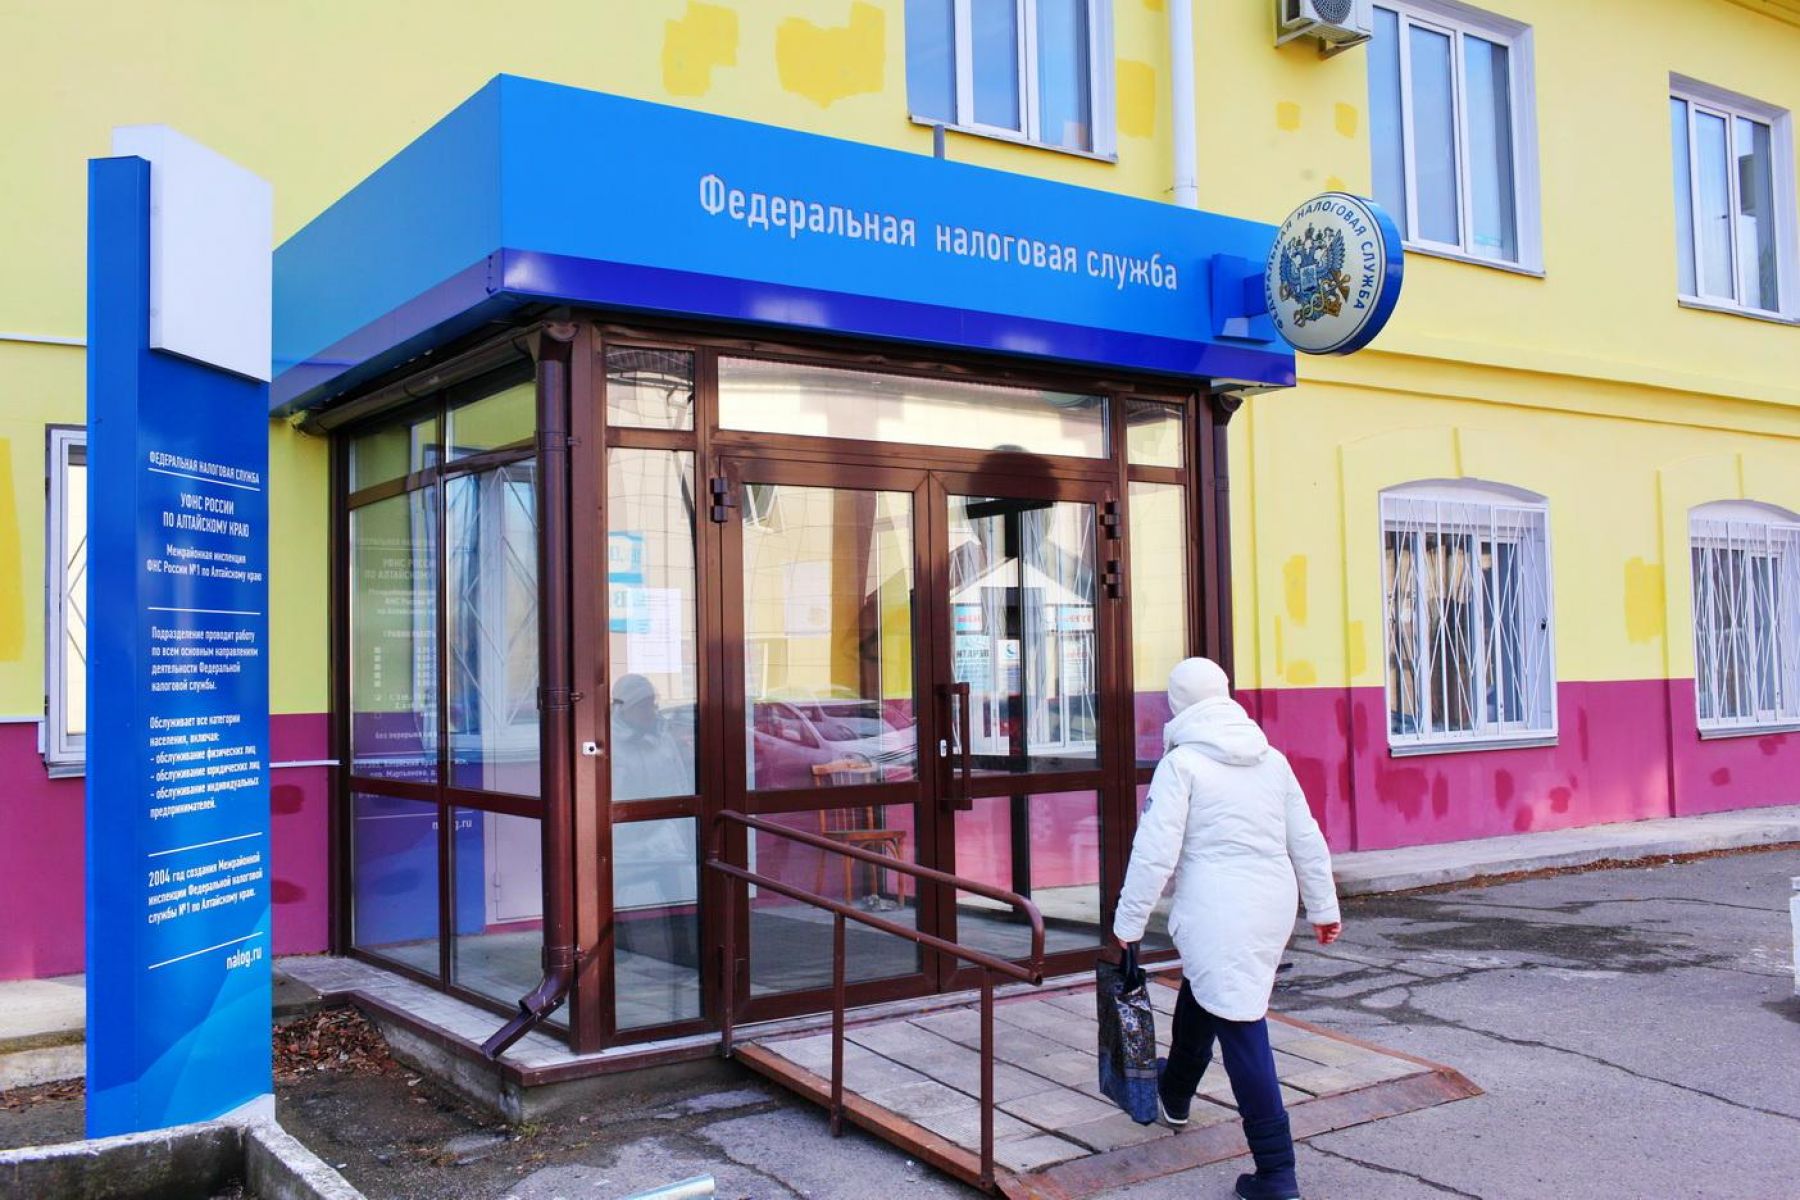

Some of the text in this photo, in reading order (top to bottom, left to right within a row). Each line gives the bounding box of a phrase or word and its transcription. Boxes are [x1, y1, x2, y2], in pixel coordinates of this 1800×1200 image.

[699, 174, 1178, 292] Федеральная налоговая служба
[1297, 201, 1366, 236] НАЛОГОВАЯ
[1355, 241, 1375, 309] СЛУЖБА
[150, 451, 260, 484] ФЕДЕРАЛЬНАЯ НАЛОГОВАЯ СЛУЖБА
[180, 493, 234, 515] УФНС РОССИИ
[163, 512, 249, 537] ПО АЛТАЙСКОМУ КРАЮ
[167, 544, 246, 564] Межрайонная инспекция
[147, 559, 161, 572] ФНС
[164, 562, 187, 575] России
[202, 568, 209, 577] по
[211, 567, 245, 582] Алтайскому
[247, 572, 262, 583] краю
[152, 626, 255, 643] Подразделение проводит работу
[152, 647, 160, 656] по
[162, 647, 179, 656] всем
[181, 647, 214, 656] основным
[152, 661, 240, 676] деятельности Федеральной
[152, 679, 192, 692] налоговой
[150, 713, 240, 731] Обслуживает все категории
[156, 749, 205, 764] обслуживание
[245, 745, 256, 756] лиц
[156, 767, 205, 782] обслуживание
[249, 761, 260, 771] лиц
[156, 785, 205, 800] обслуживание
[149, 852, 260, 887] 2004 год создания Межрайонной
[188, 876, 231, 896] Федеральной
[232, 868, 263, 885] налоговой
[148, 907, 177, 925] службы
[192, 903, 200, 912] по
[201, 894, 237, 909] Алтайскому
[226, 947, 262, 970] nalog.ru
